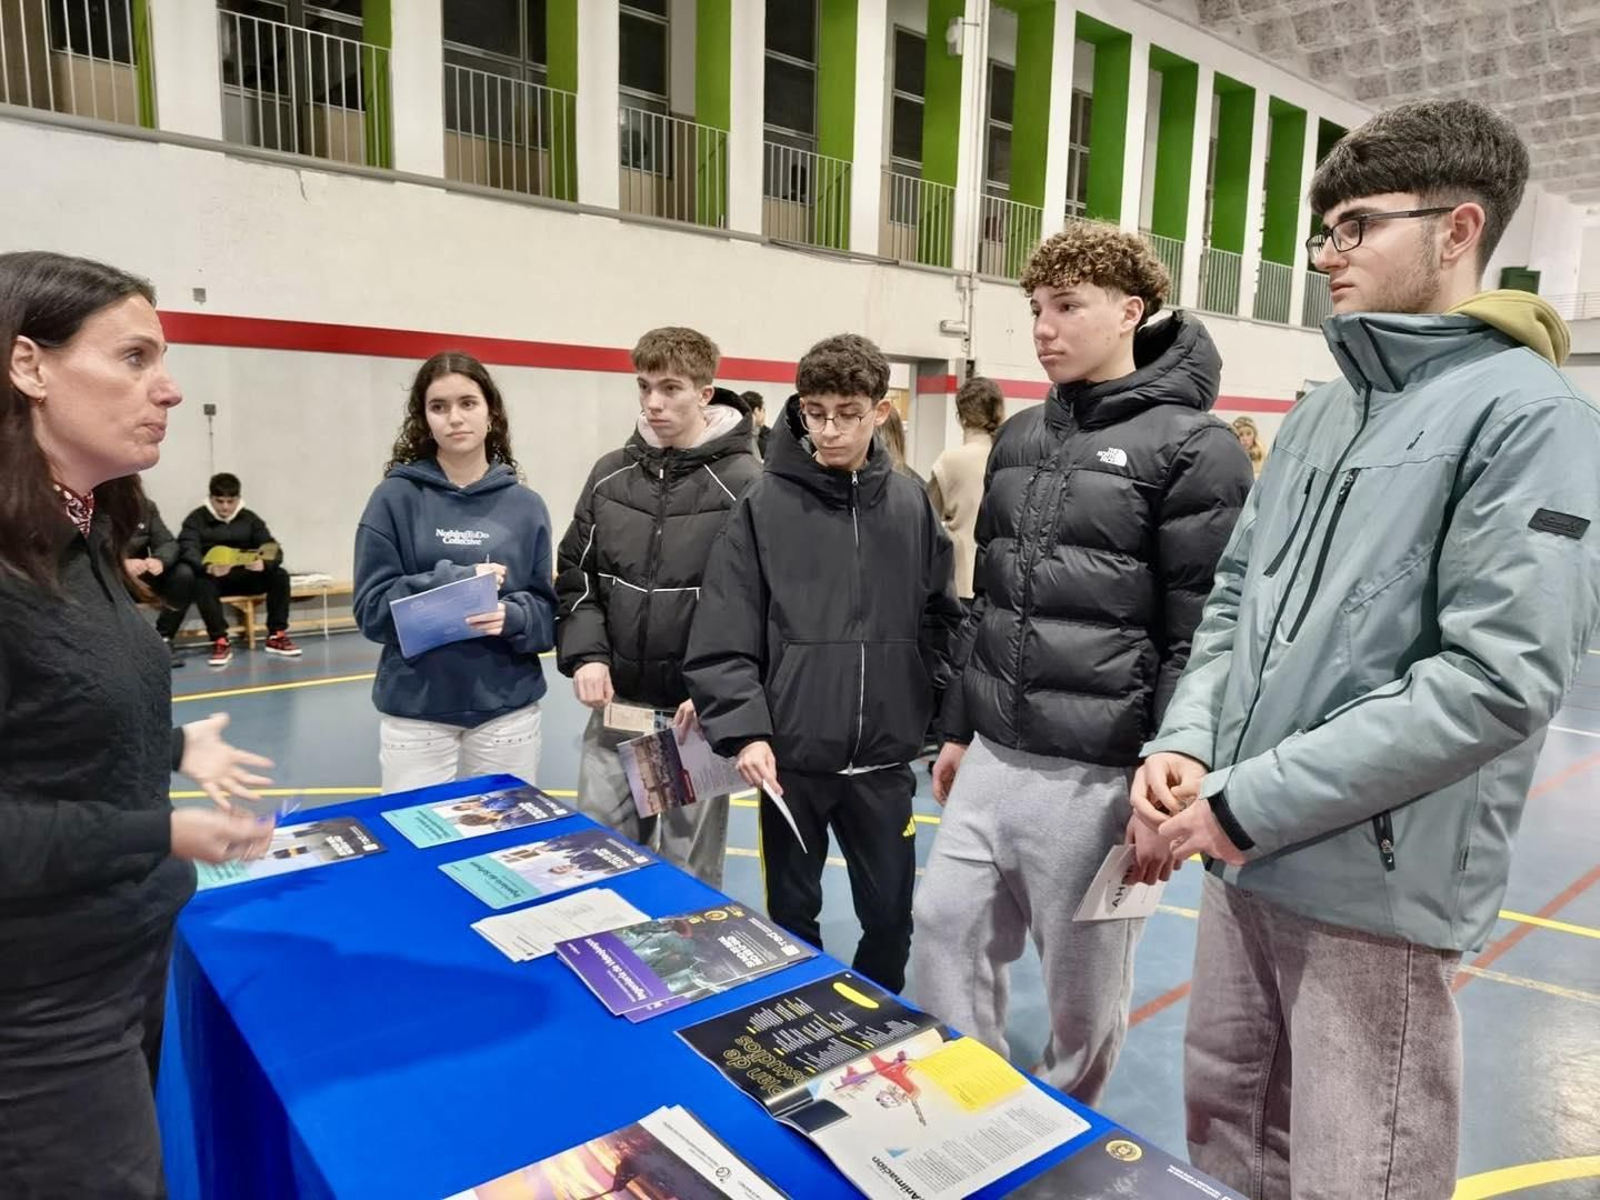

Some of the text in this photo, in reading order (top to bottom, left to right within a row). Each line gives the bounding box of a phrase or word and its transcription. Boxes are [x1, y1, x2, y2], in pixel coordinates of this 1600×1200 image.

[722, 1048, 752, 1069] de
[734, 1035, 810, 1087] estudios
[871, 1156, 921, 1199] Animación
